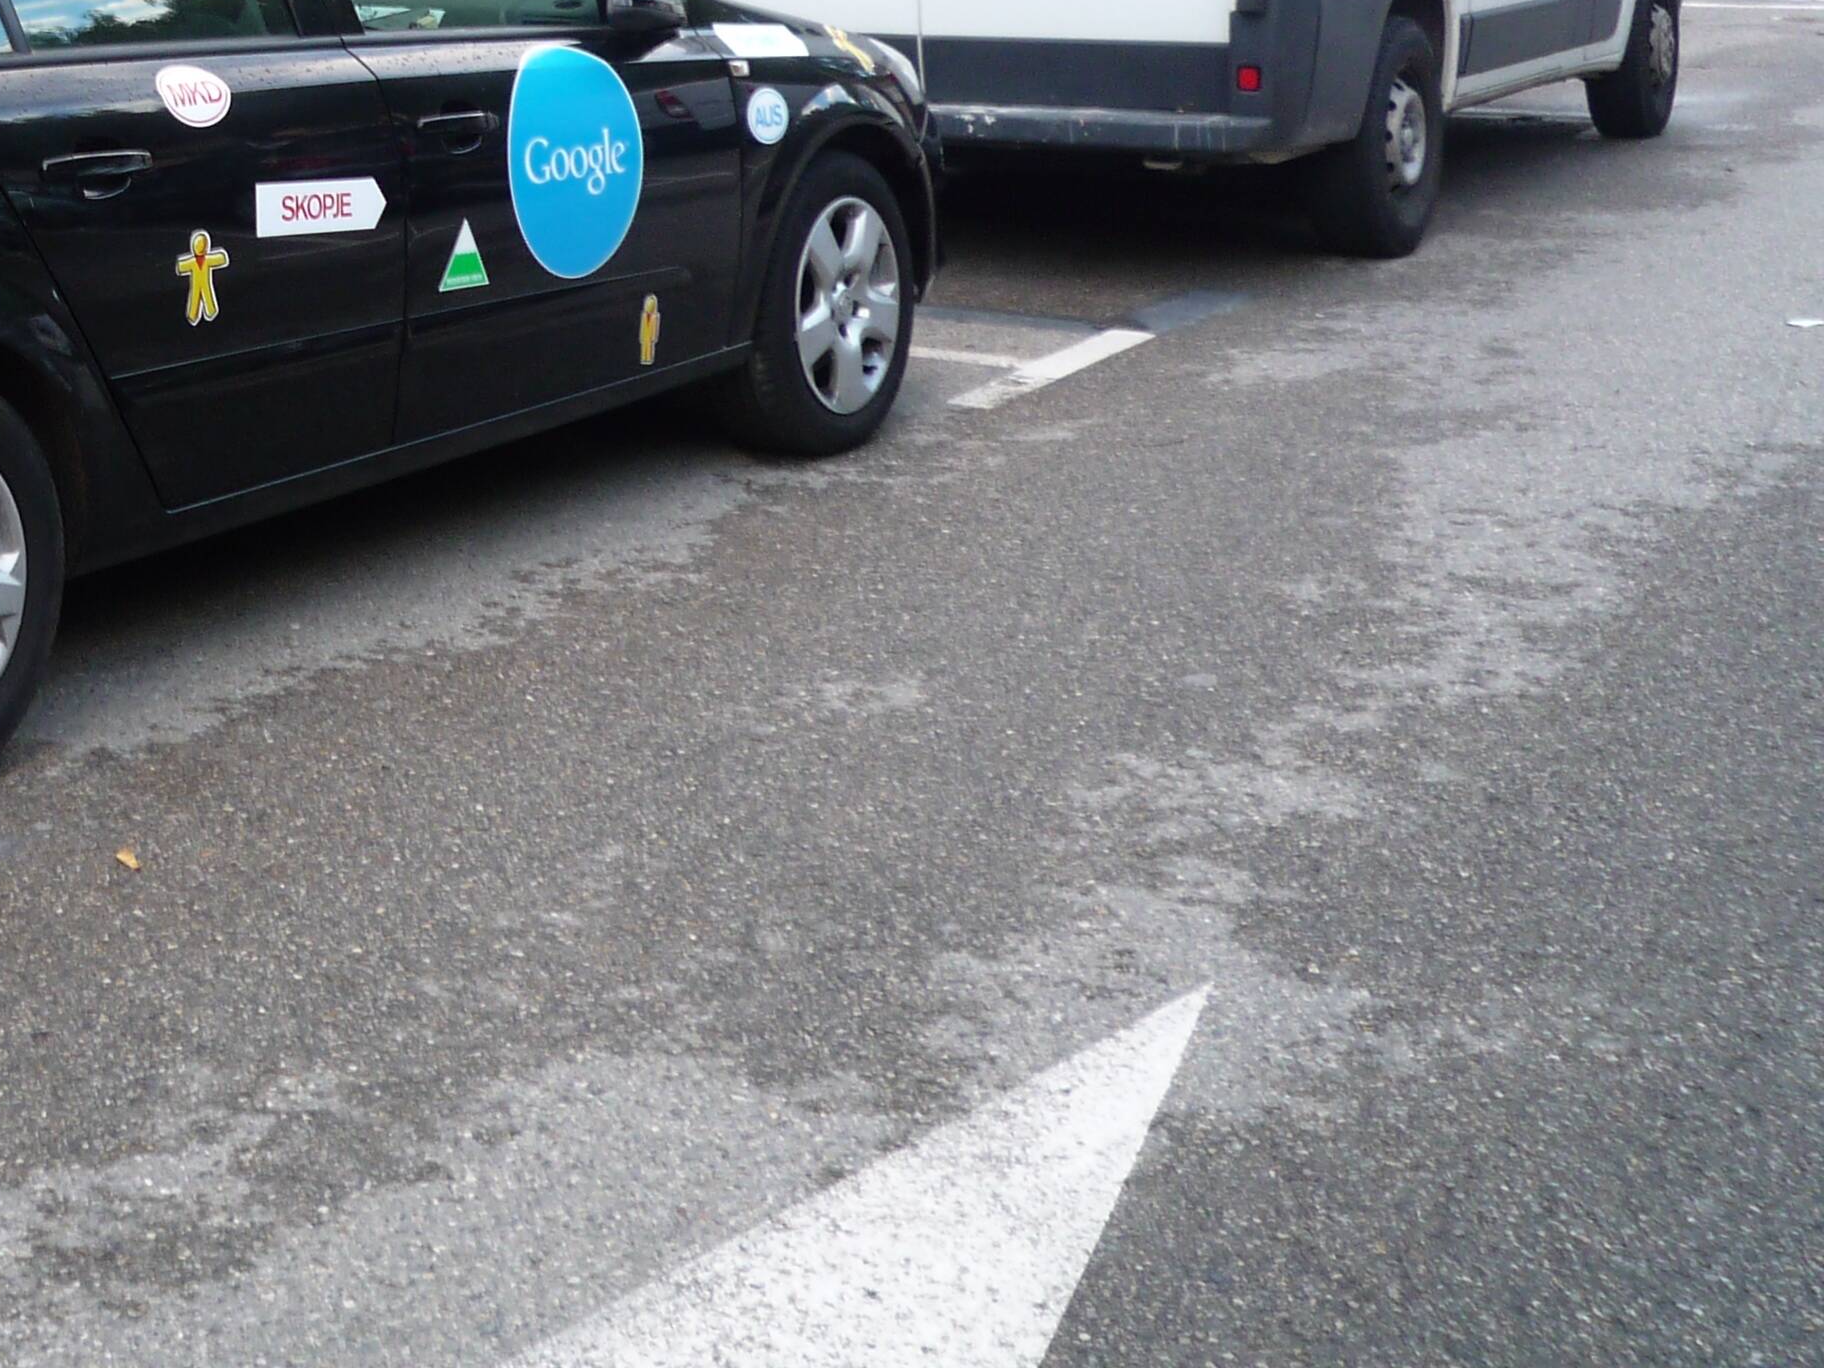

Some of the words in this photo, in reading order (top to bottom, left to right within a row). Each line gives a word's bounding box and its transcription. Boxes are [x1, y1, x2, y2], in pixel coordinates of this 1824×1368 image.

[167, 79, 223, 109] MKD
[754, 103, 784, 127] AUS
[524, 127, 627, 196] Google
[281, 192, 353, 222] SKOPJE
